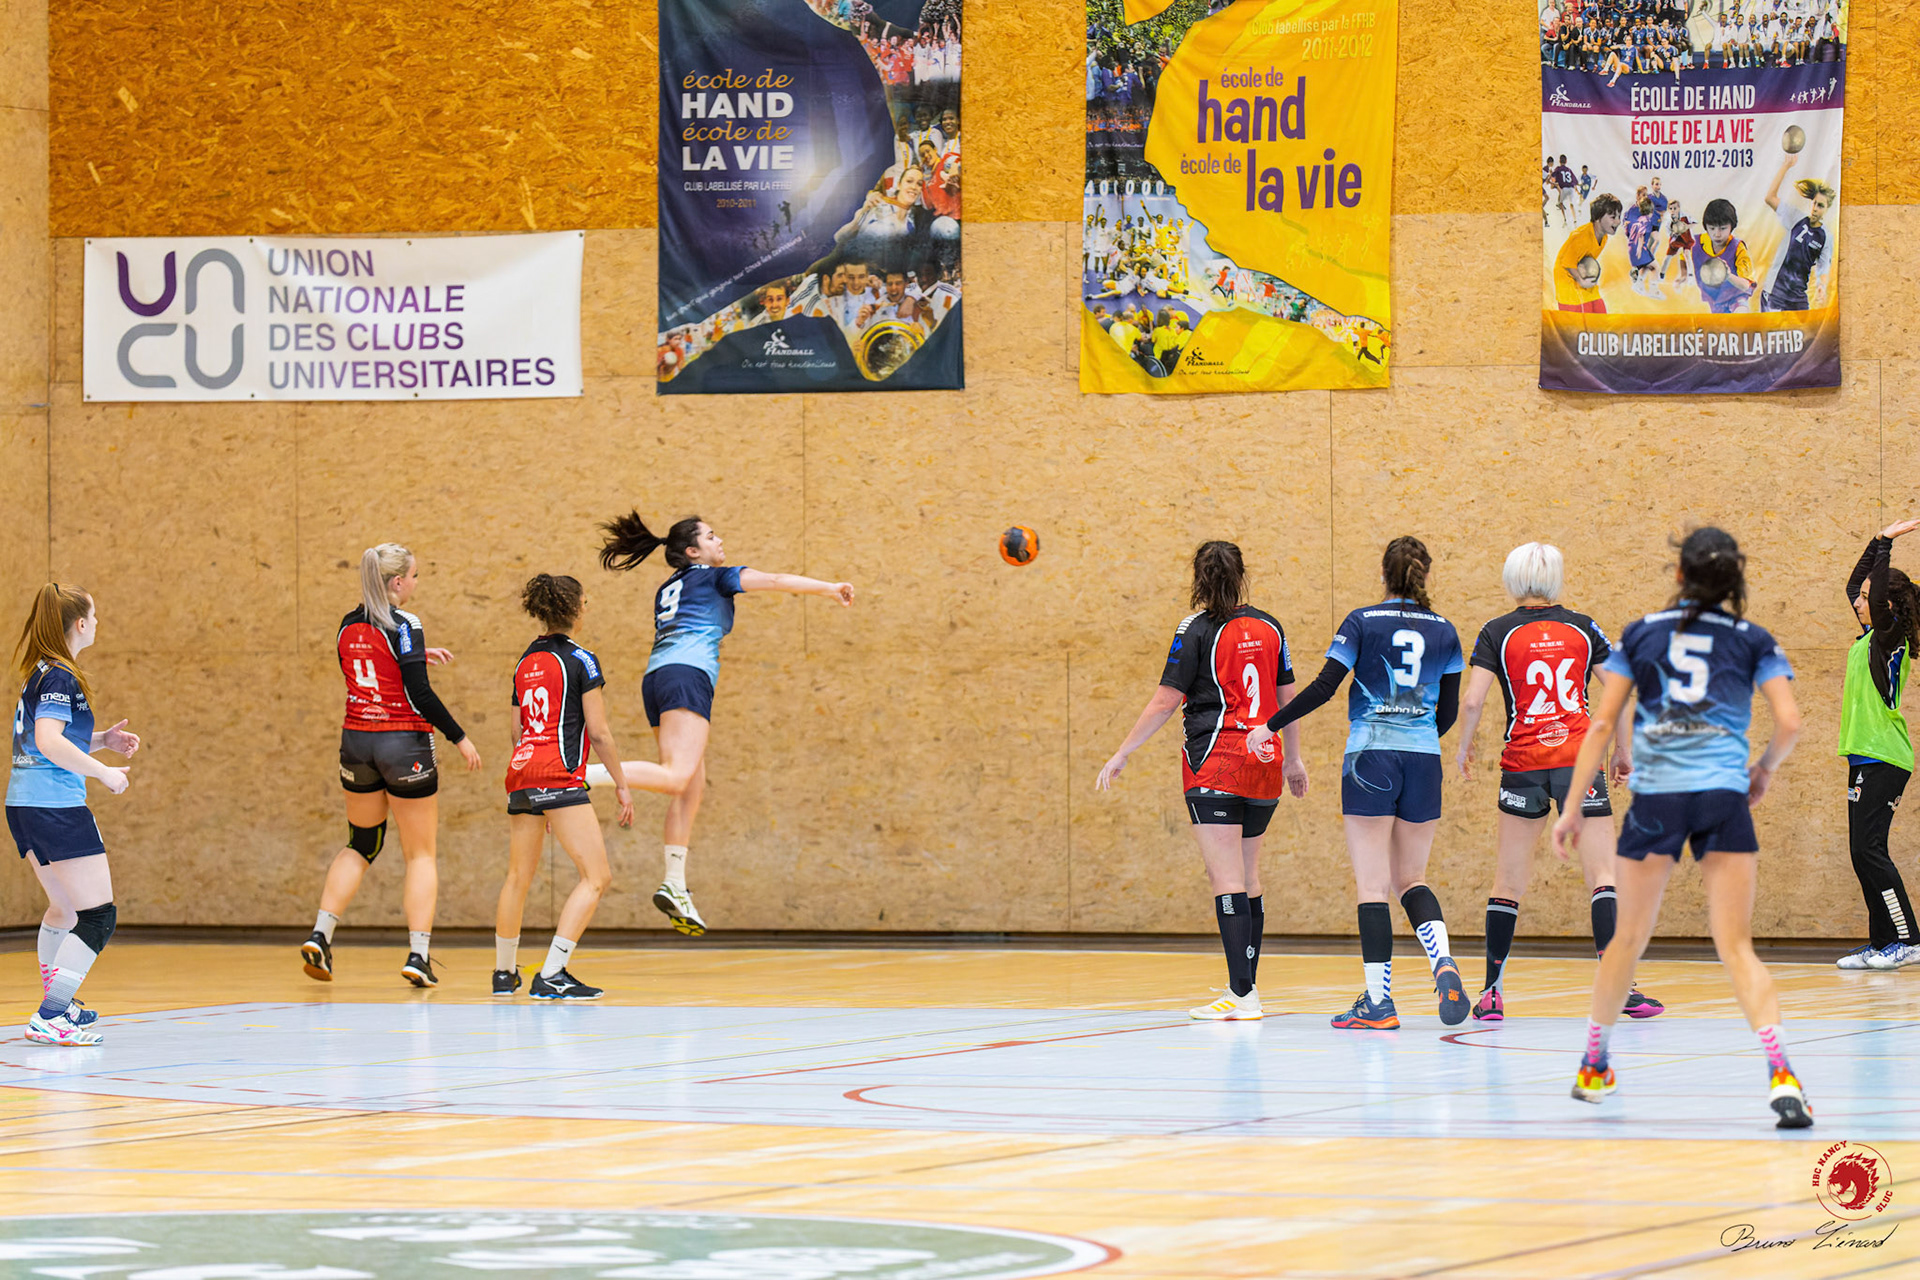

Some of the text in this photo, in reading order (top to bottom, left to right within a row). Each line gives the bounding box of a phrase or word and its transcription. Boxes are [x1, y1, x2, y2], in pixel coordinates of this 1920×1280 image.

[1252, 21, 1273, 35] Club
[1321, 19, 1339, 35] par
[1341, 14, 1349, 29] la
[1351, 12, 1376, 29] FFHB
[1302, 33, 1373, 60] 2011-2012
[682, 67, 794, 89] école de
[1220, 65, 1283, 88] école de
[681, 92, 794, 119] HAND
[1197, 76, 1306, 144] hand
[1630, 82, 1756, 112] ÉCOLE DE HAND
[681, 120, 794, 141] école de
[1631, 115, 1754, 145] ÉCOLE DE LA VIE
[681, 145, 794, 171] LA VIE
[1632, 149, 1754, 170] SAISON 2012-2013
[683, 181, 704, 192] CLUB
[704, 179, 743, 191] LABELLISÉ
[743, 181, 759, 191] PAR
[760, 181, 771, 191] LA
[1181, 148, 1362, 213] école de la vie
[1560, 171, 1572, 183] 13
[267, 248, 375, 278] UNION
[268, 285, 465, 314] NATIONALE
[268, 321, 465, 351] DES CLUBS
[1577, 328, 1804, 357] CLUB LABELLISÉ PAR LA FFHB
[268, 358, 556, 390] UNIVERSITAIRES
[656, 578, 683, 622] 9
[1392, 628, 1425, 698] 3
[1667, 630, 1714, 704] 5
[352, 658, 381, 702] 4
[1526, 658, 1579, 716] 26
